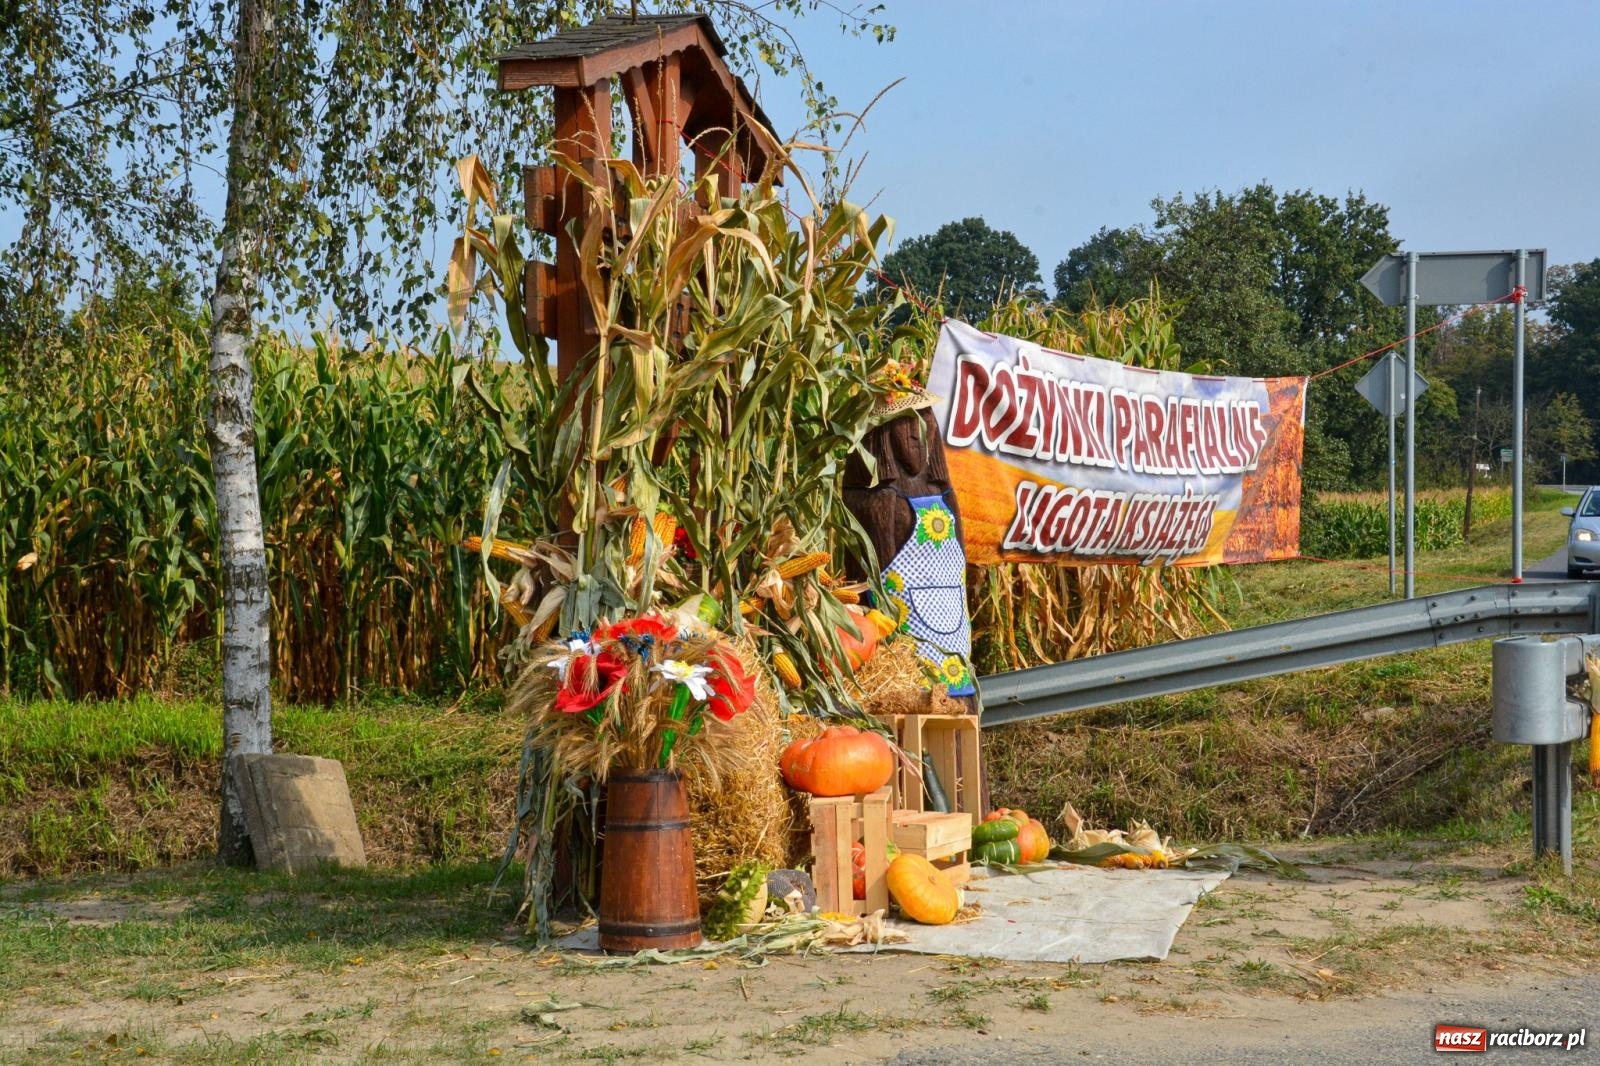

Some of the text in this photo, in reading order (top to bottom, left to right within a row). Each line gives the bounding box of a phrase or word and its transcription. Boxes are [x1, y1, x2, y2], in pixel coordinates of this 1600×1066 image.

[947, 351, 1267, 474] DOŻYNKI PARAFIALNE
[1004, 481, 1219, 566] LIGOTA KSIĄŻĘCA
